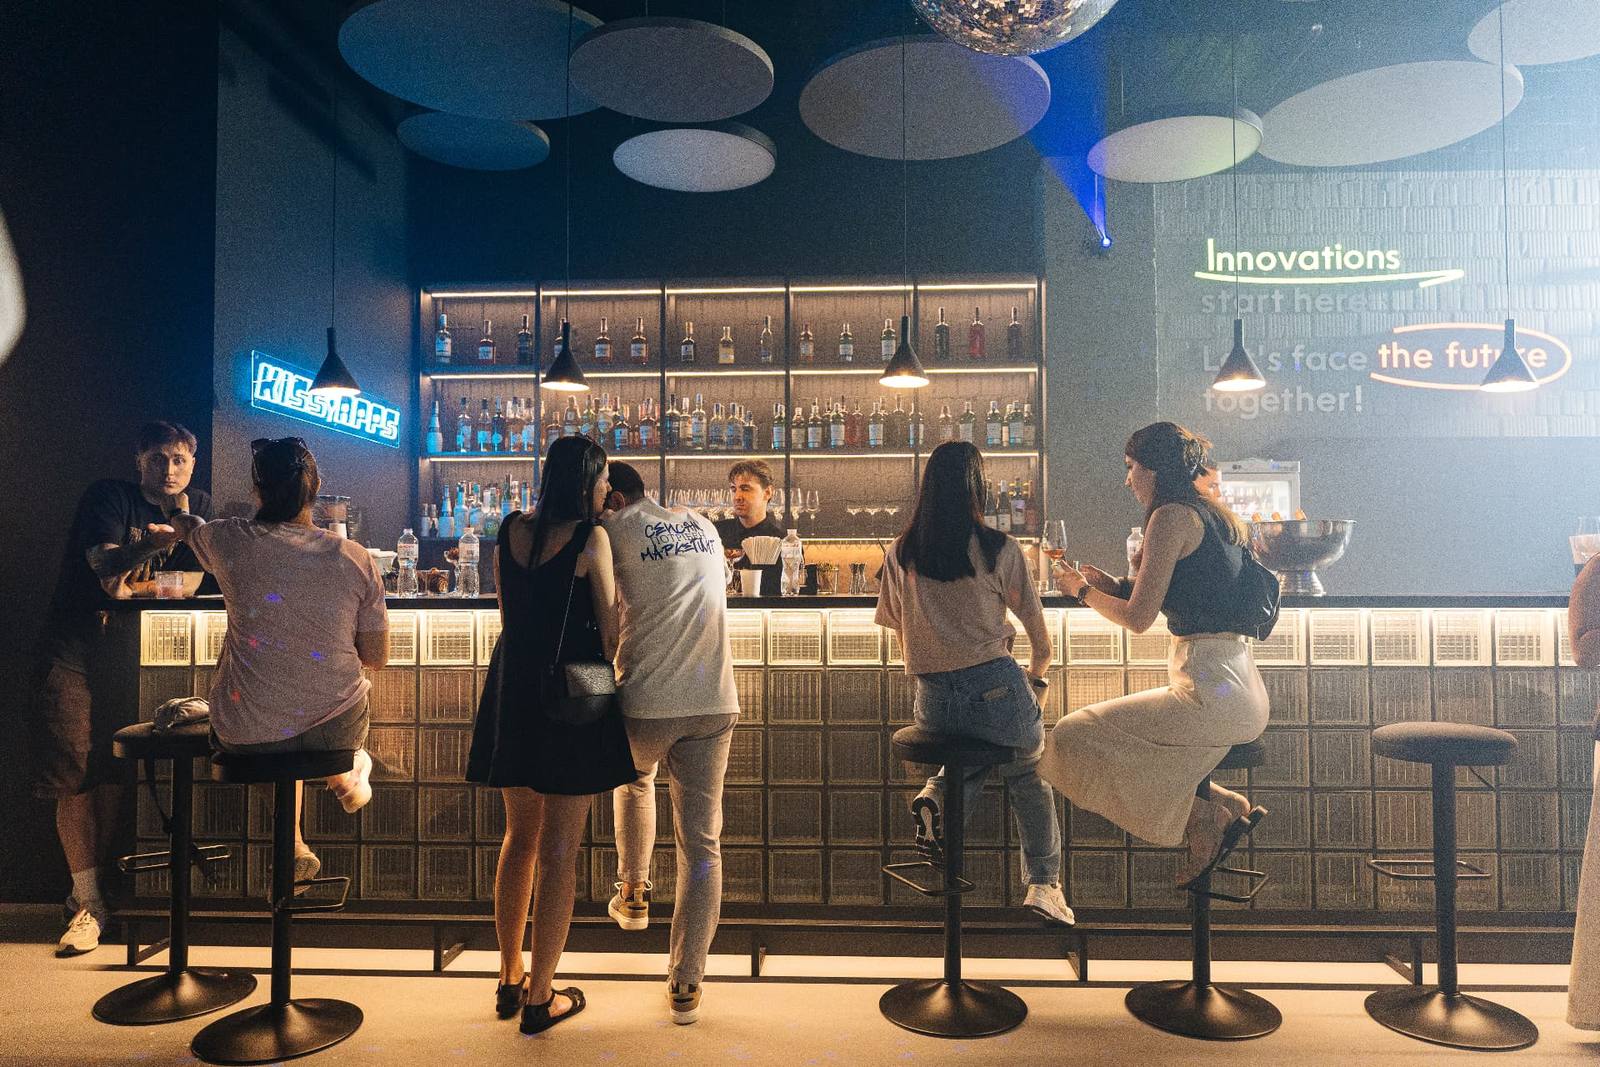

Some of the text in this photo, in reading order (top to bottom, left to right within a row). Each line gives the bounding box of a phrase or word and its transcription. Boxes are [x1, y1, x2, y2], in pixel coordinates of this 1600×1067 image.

[1206, 238, 1401, 272] Innovations
[1201, 289, 1285, 314] start
[1203, 345, 1282, 372] L's
[1291, 344, 1367, 372] face
[1377, 341, 1433, 369] the
[1203, 384, 1363, 419] together!
